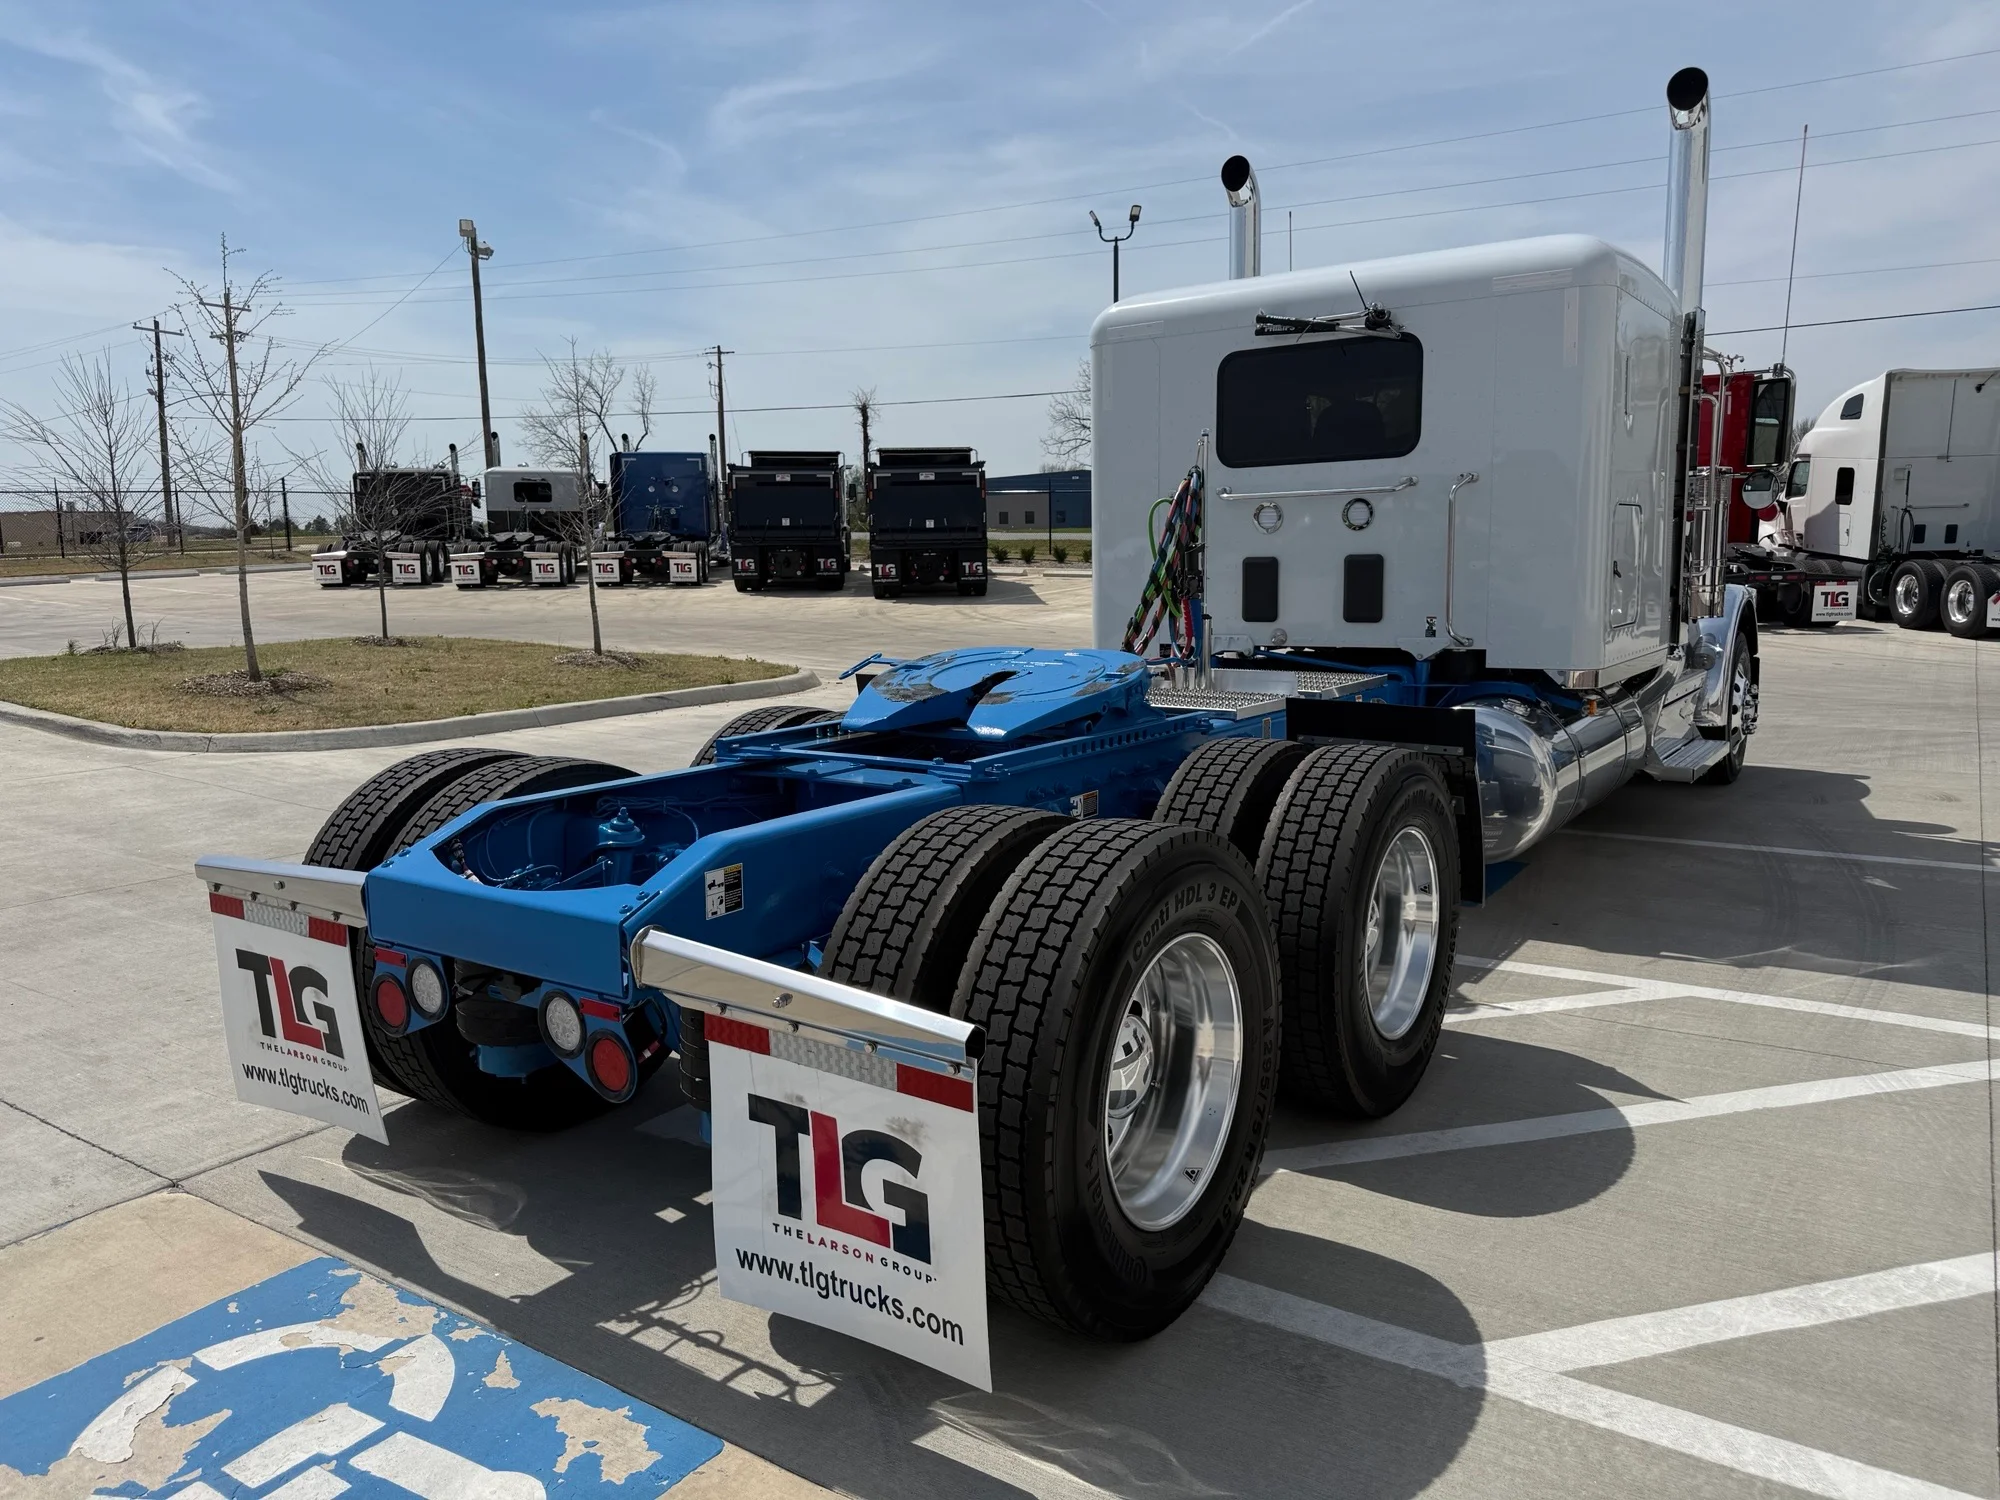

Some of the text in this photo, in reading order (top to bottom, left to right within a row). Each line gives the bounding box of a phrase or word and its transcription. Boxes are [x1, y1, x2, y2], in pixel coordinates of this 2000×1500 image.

[317, 564, 336, 575] TLG
[397, 563, 415, 574] TLG
[455, 564, 474, 575] TLG
[535, 563, 555, 574] TLG
[595, 563, 614, 574] TLG
[673, 562, 692, 573] TLG
[734, 558, 755, 570] TLG
[817, 557, 837, 569] TLG
[874, 563, 896, 577] TLG
[962, 560, 983, 576] TLG
[1820, 591, 1849, 608] TLG
[1132, 901, 1170, 962] Conti
[1174, 883, 1203, 913] HDL
[1207, 882, 1217, 902] 3
[1219, 885, 1238, 910] EP
[235, 948, 345, 1060] TLG
[320, 1057, 348, 1073] GROUP
[242, 1063, 370, 1115] www.tlgtrucks.com
[1251, 1039, 1273, 1137] 295/75
[1244, 1141, 1257, 1163] R
[747, 1092, 932, 1266] TLG
[880, 1257, 933, 1284] GROUP
[735, 1248, 964, 1346] www.tlgtrucks.com
